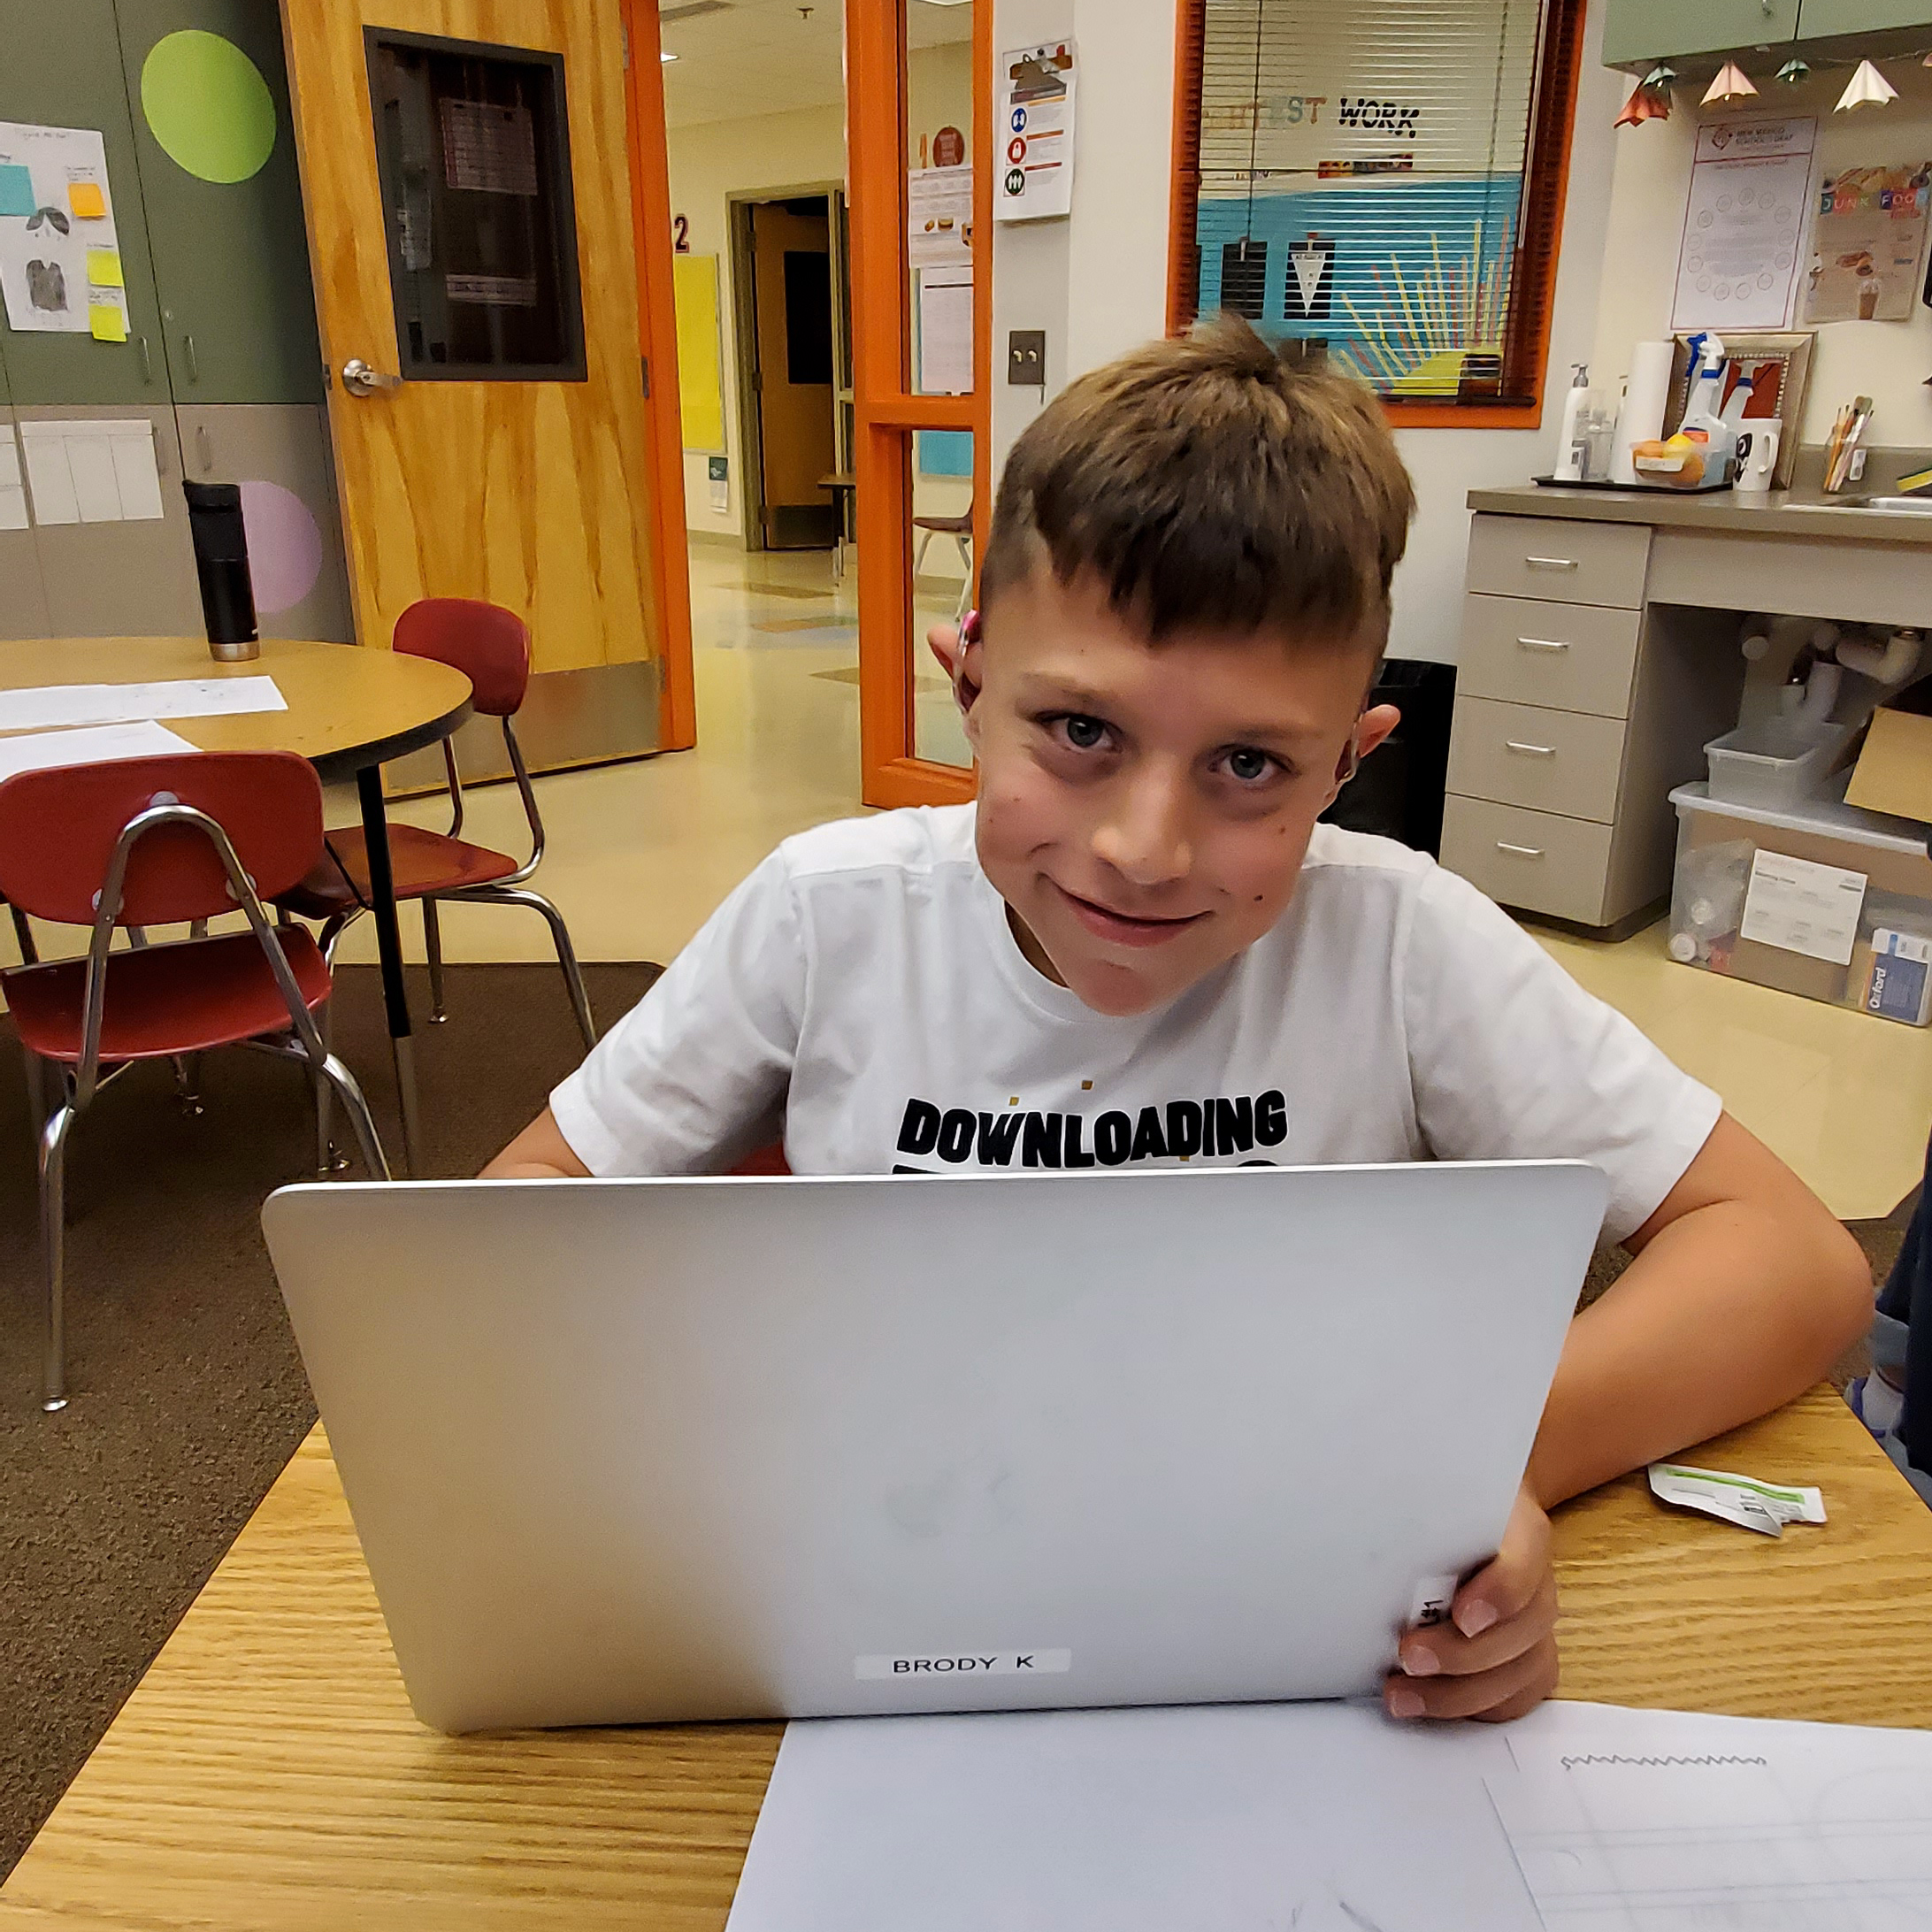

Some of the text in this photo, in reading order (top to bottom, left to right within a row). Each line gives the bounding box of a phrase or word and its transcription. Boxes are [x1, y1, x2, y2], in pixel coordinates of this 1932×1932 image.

[1338, 97, 1420, 139] WORK
[674, 213, 690, 253] 2
[1868, 966, 1887, 1009] Oxford
[896, 1089, 1288, 1169] DOWNLOADING
[893, 1655, 1035, 1674] BRODY K
